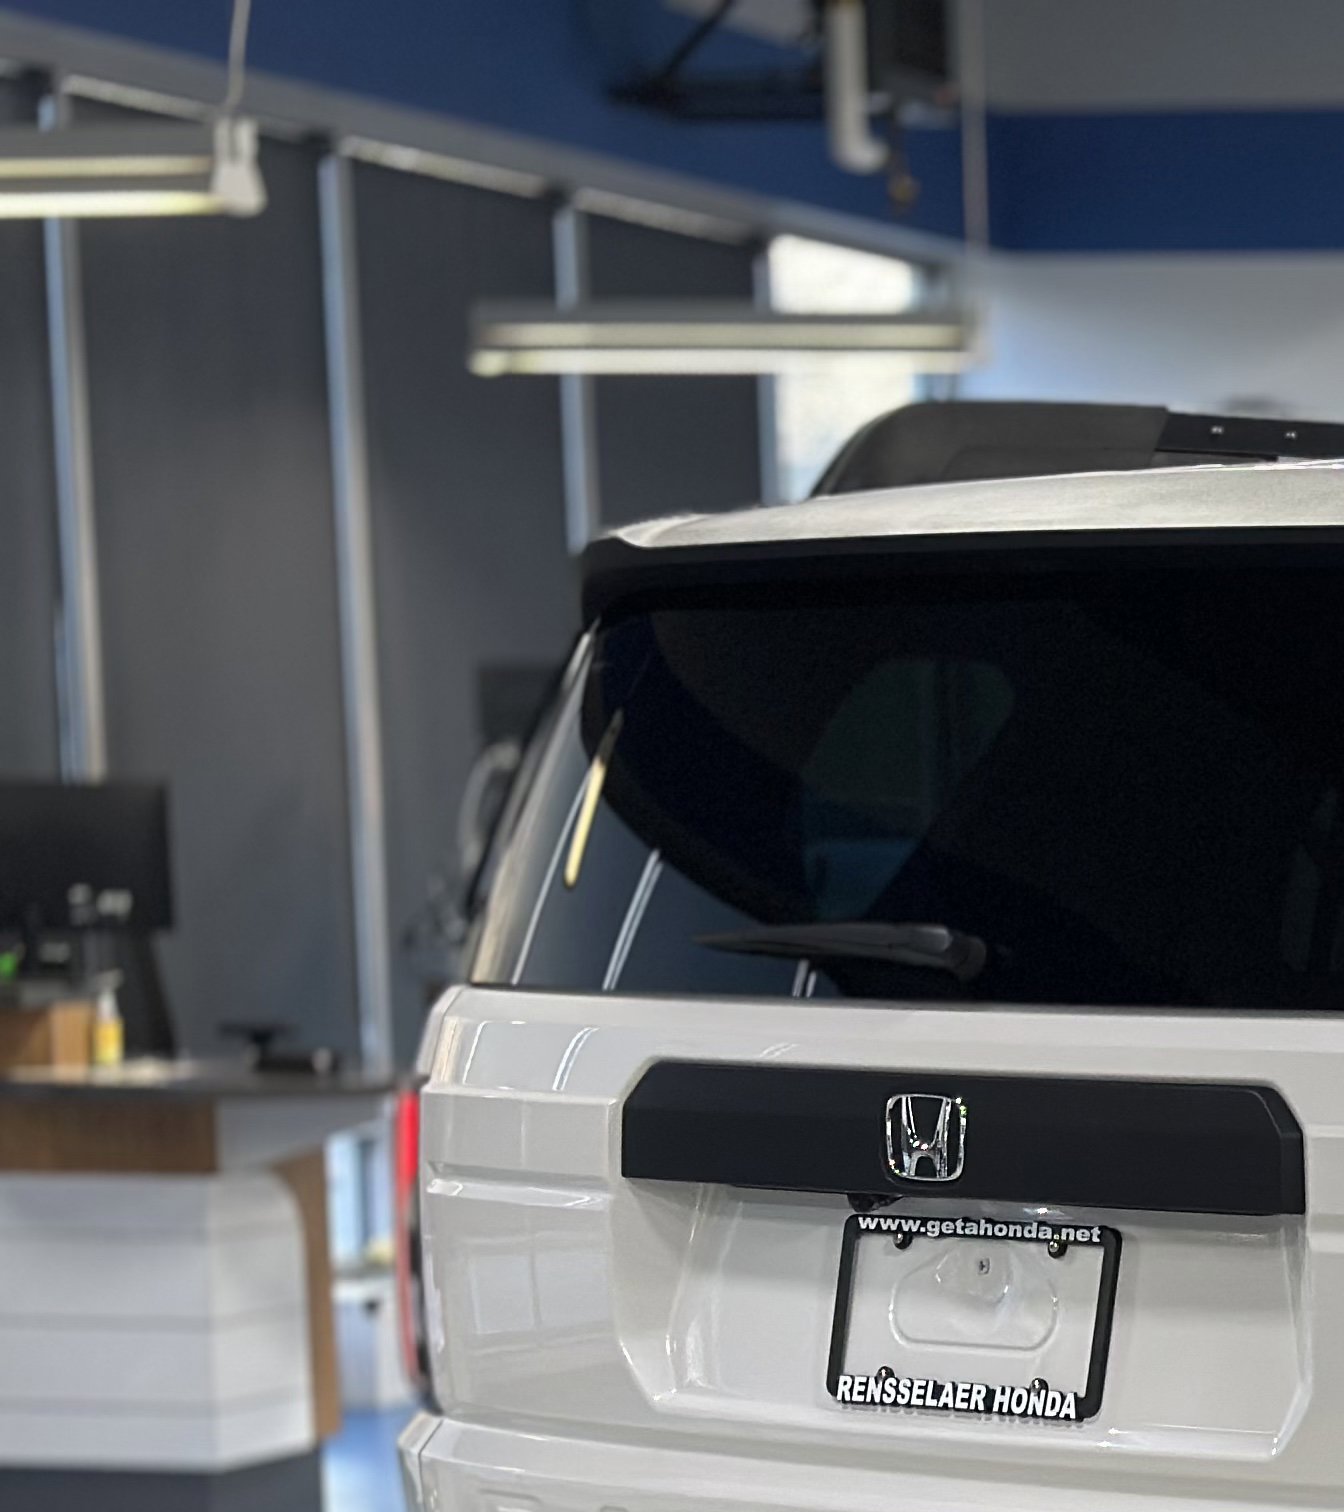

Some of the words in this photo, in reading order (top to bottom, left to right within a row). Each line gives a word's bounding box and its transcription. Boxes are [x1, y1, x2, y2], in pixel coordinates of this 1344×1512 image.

[858, 1216, 1102, 1243] www.getahonda.net
[836, 1375, 986, 1411] RENSSELAER
[992, 1385, 1077, 1419] HONDA
